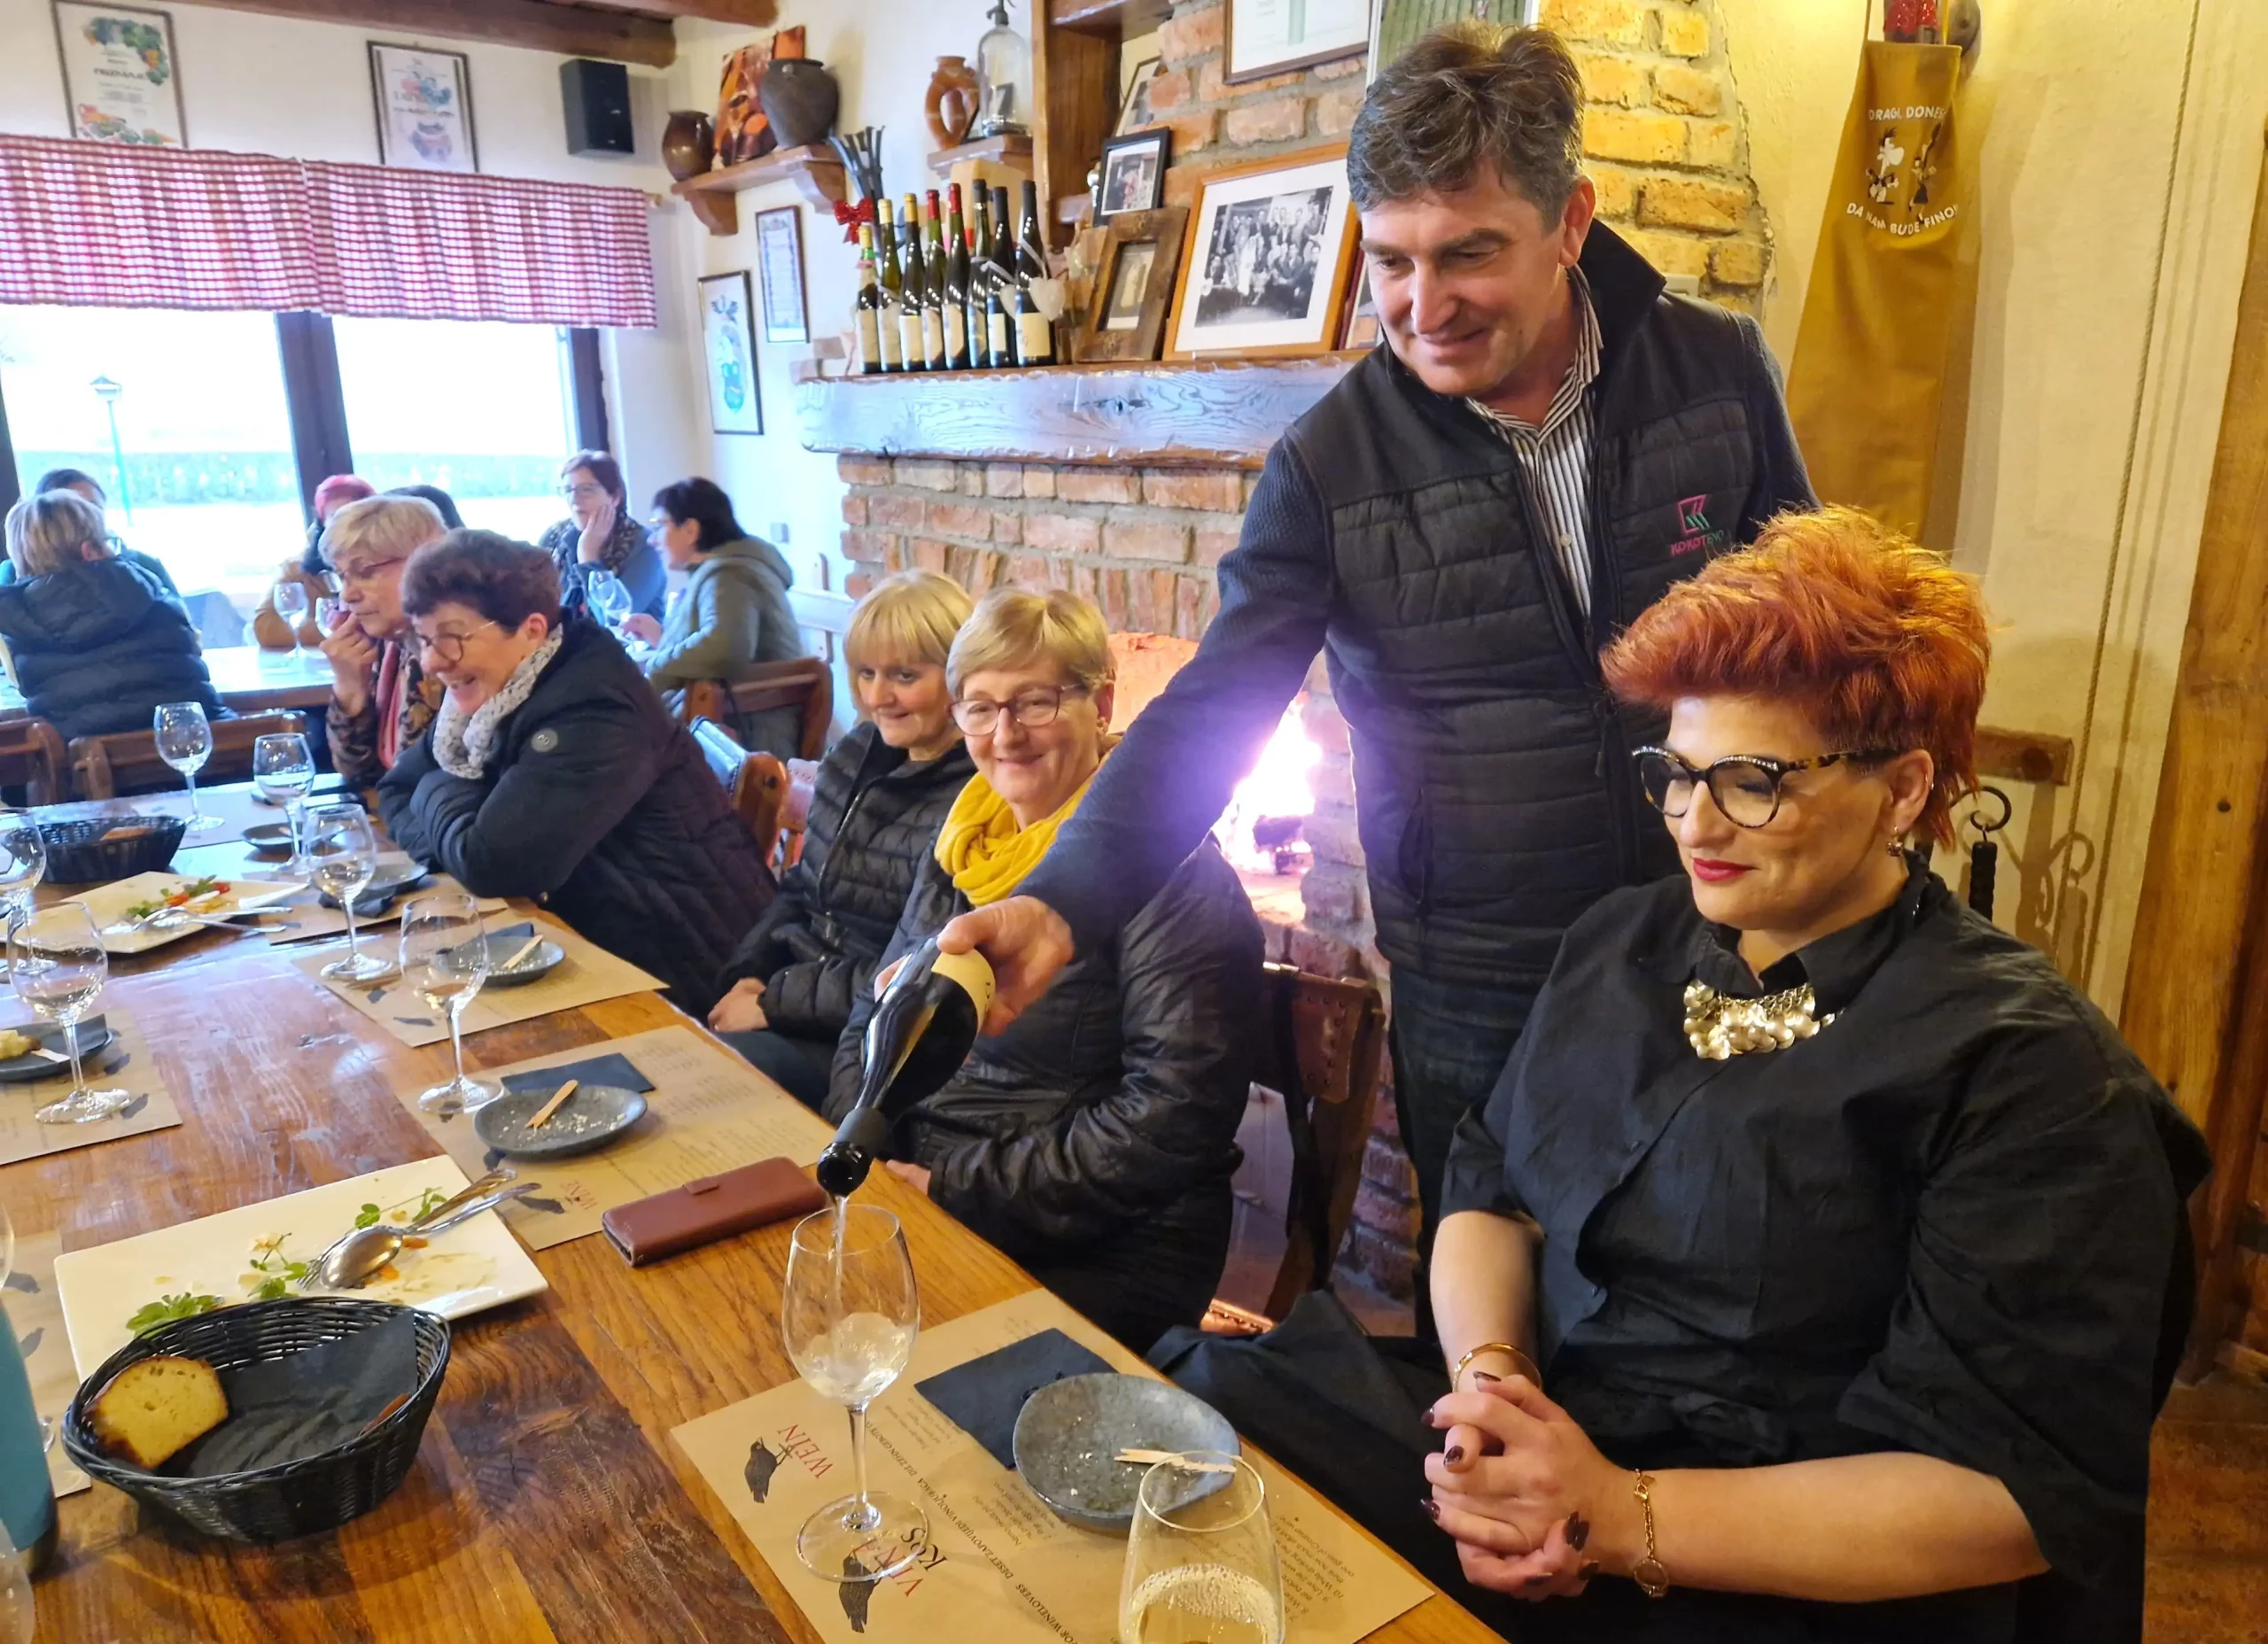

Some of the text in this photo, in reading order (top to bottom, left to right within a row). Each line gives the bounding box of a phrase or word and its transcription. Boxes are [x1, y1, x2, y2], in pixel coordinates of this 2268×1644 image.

[1847, 203, 1864, 217] DA
[1865, 212, 1886, 229] NAM
[1890, 221, 1921, 236] BUDE
[776, 1423, 834, 1479] WEIN
[904, 1463, 917, 1477] DIE
[989, 1555, 1014, 1580] DESET
[1014, 1583, 1063, 1632] WINELOVERS
